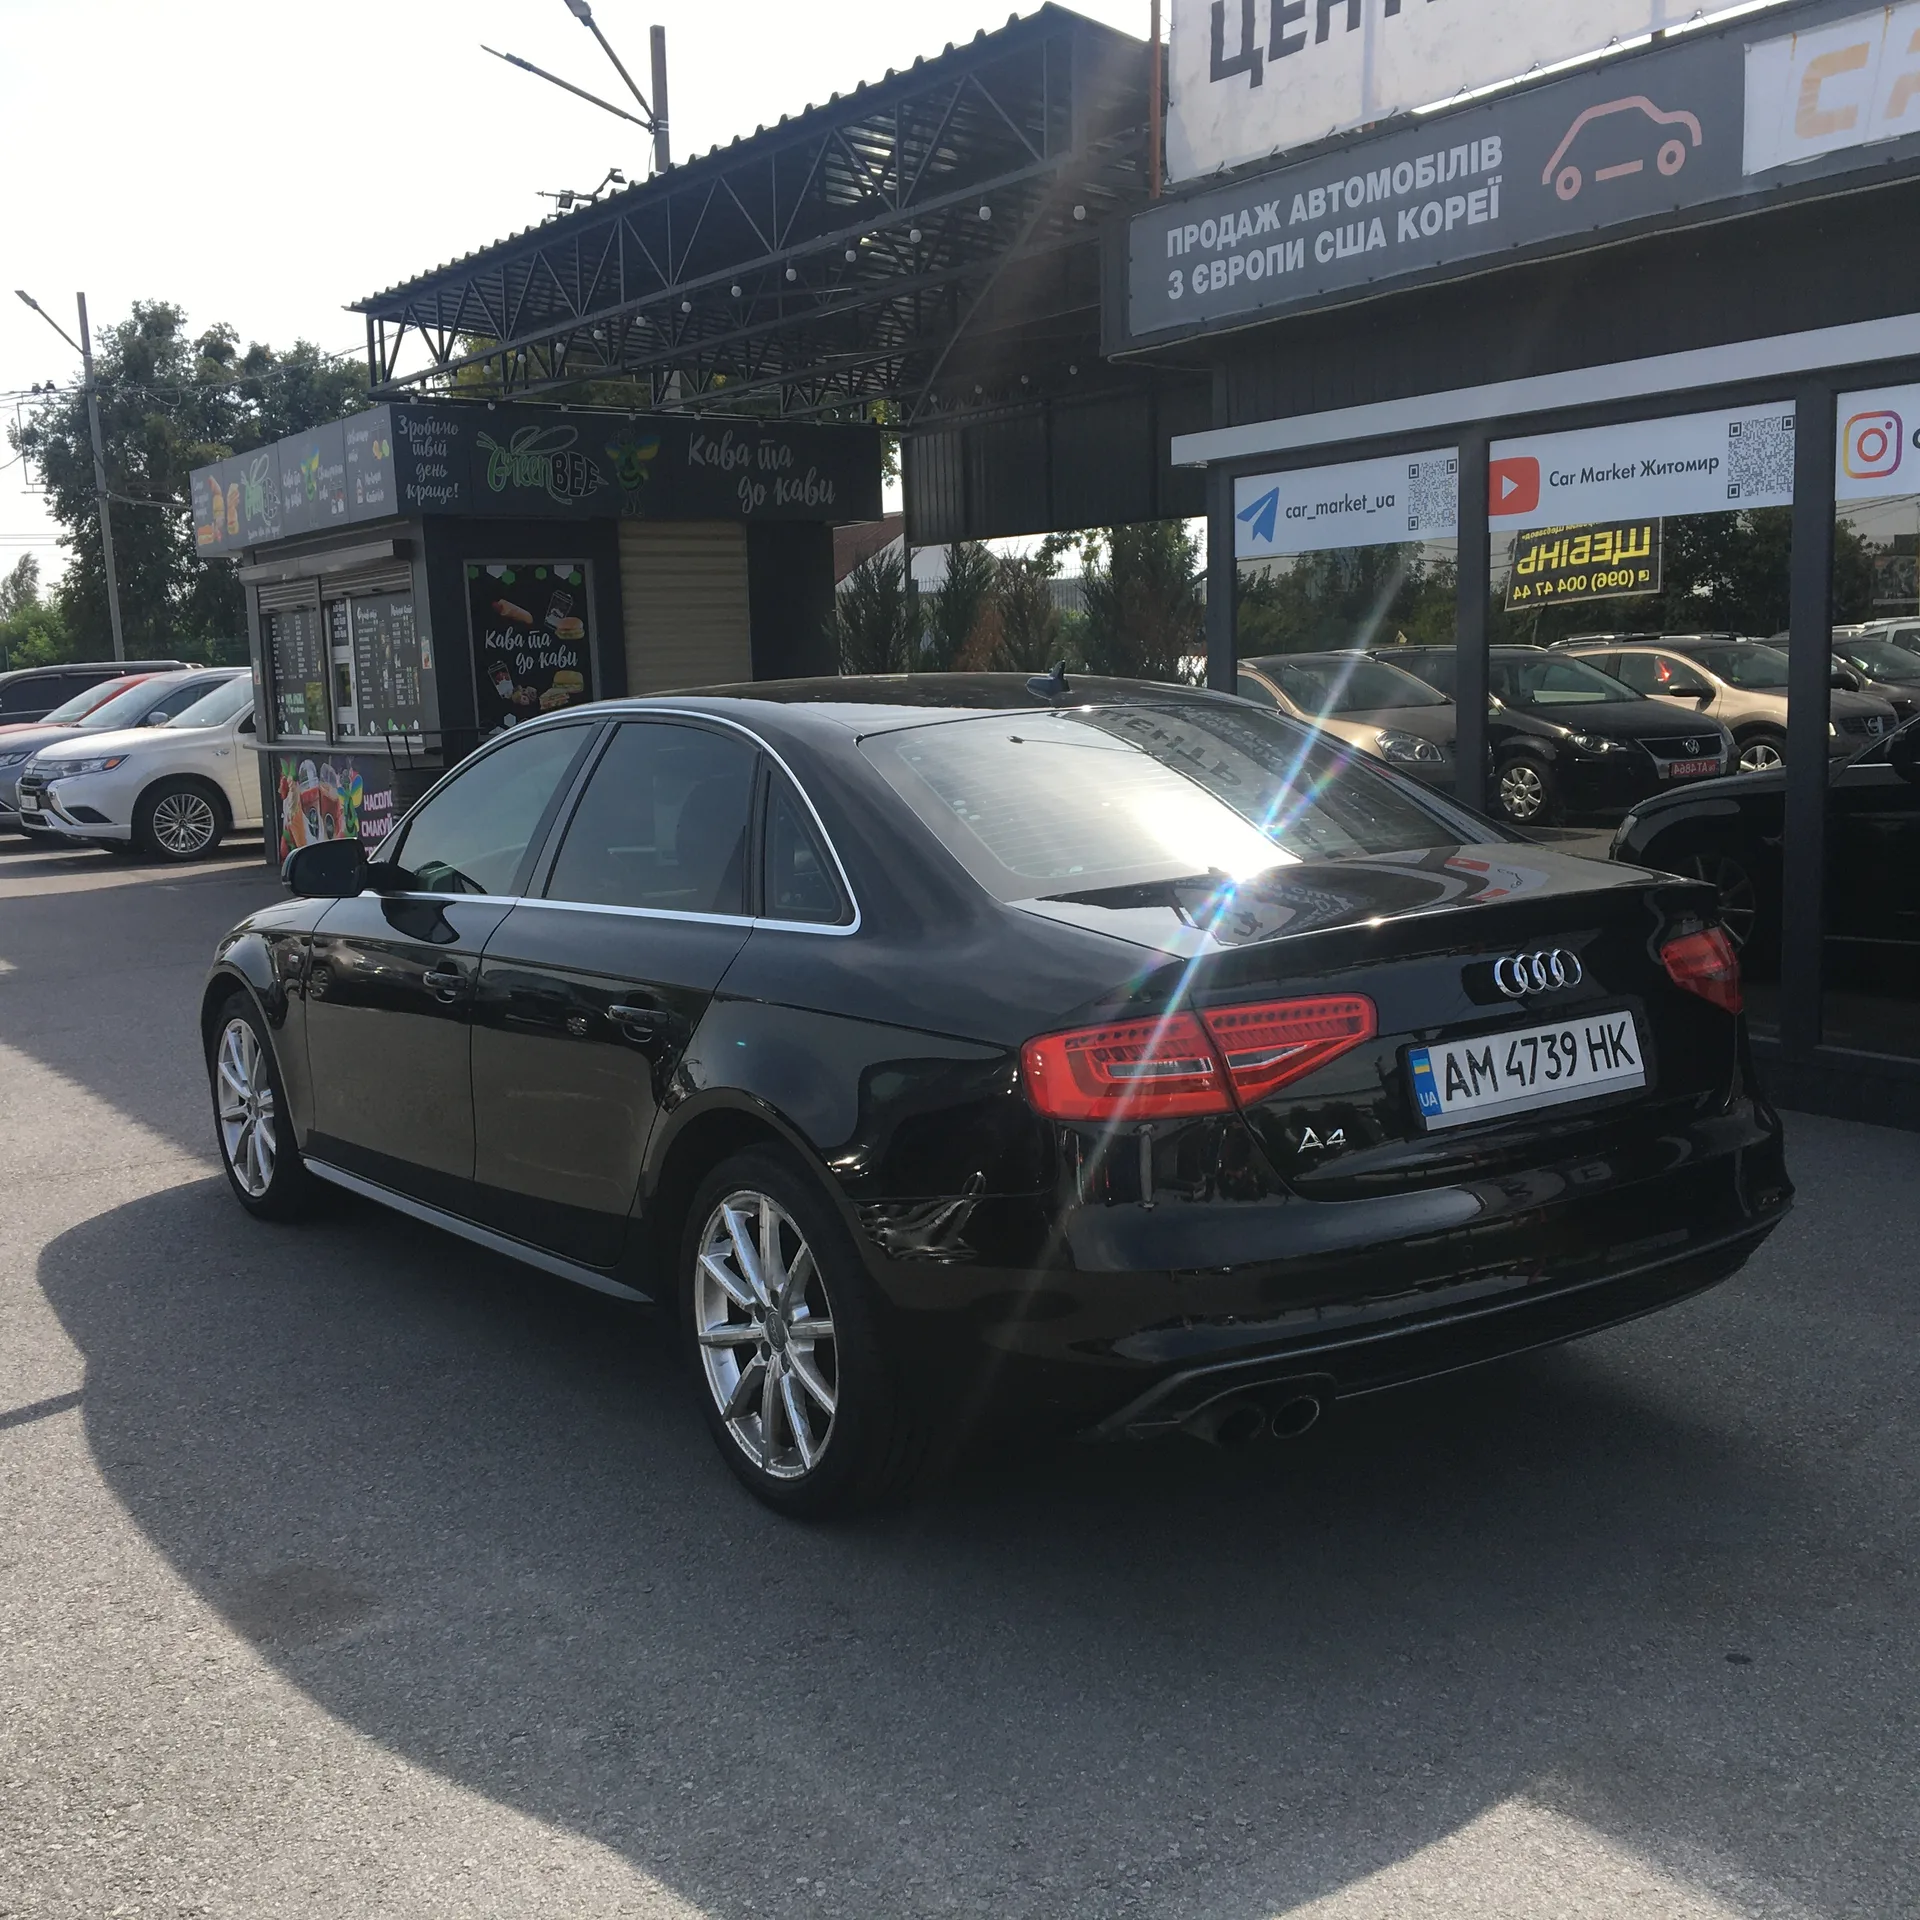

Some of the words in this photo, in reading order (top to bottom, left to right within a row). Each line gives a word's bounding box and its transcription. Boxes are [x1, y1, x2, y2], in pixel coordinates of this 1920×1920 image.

[1167, 199, 1281, 258] ПРОДАЖ
[1288, 135, 1503, 226] АВТОМОБІЛІВ
[1168, 269, 1184, 300] З
[1192, 237, 1305, 294] ЄВРОПИ
[1314, 216, 1388, 264] США
[1397, 175, 1503, 243] КОРЕЇ
[687, 429, 752, 471] Кава
[757, 438, 795, 471] та
[415, 461, 449, 483] день
[1549, 469, 1577, 487] Car
[1579, 462, 1637, 484] Market
[1639, 456, 1721, 478] Житомир
[406, 482, 459, 506] краще!
[737, 475, 768, 514] до
[773, 465, 837, 507] кави
[1285, 492, 1396, 520] car_market_ua
[484, 626, 526, 651] Кава
[528, 629, 553, 649] та
[515, 651, 535, 675] до
[538, 644, 579, 669] кави
[1505, 1031, 1577, 1087] 4739
[1421, 1092, 1439, 1107] UA
[1297, 1126, 1347, 1153] A4
